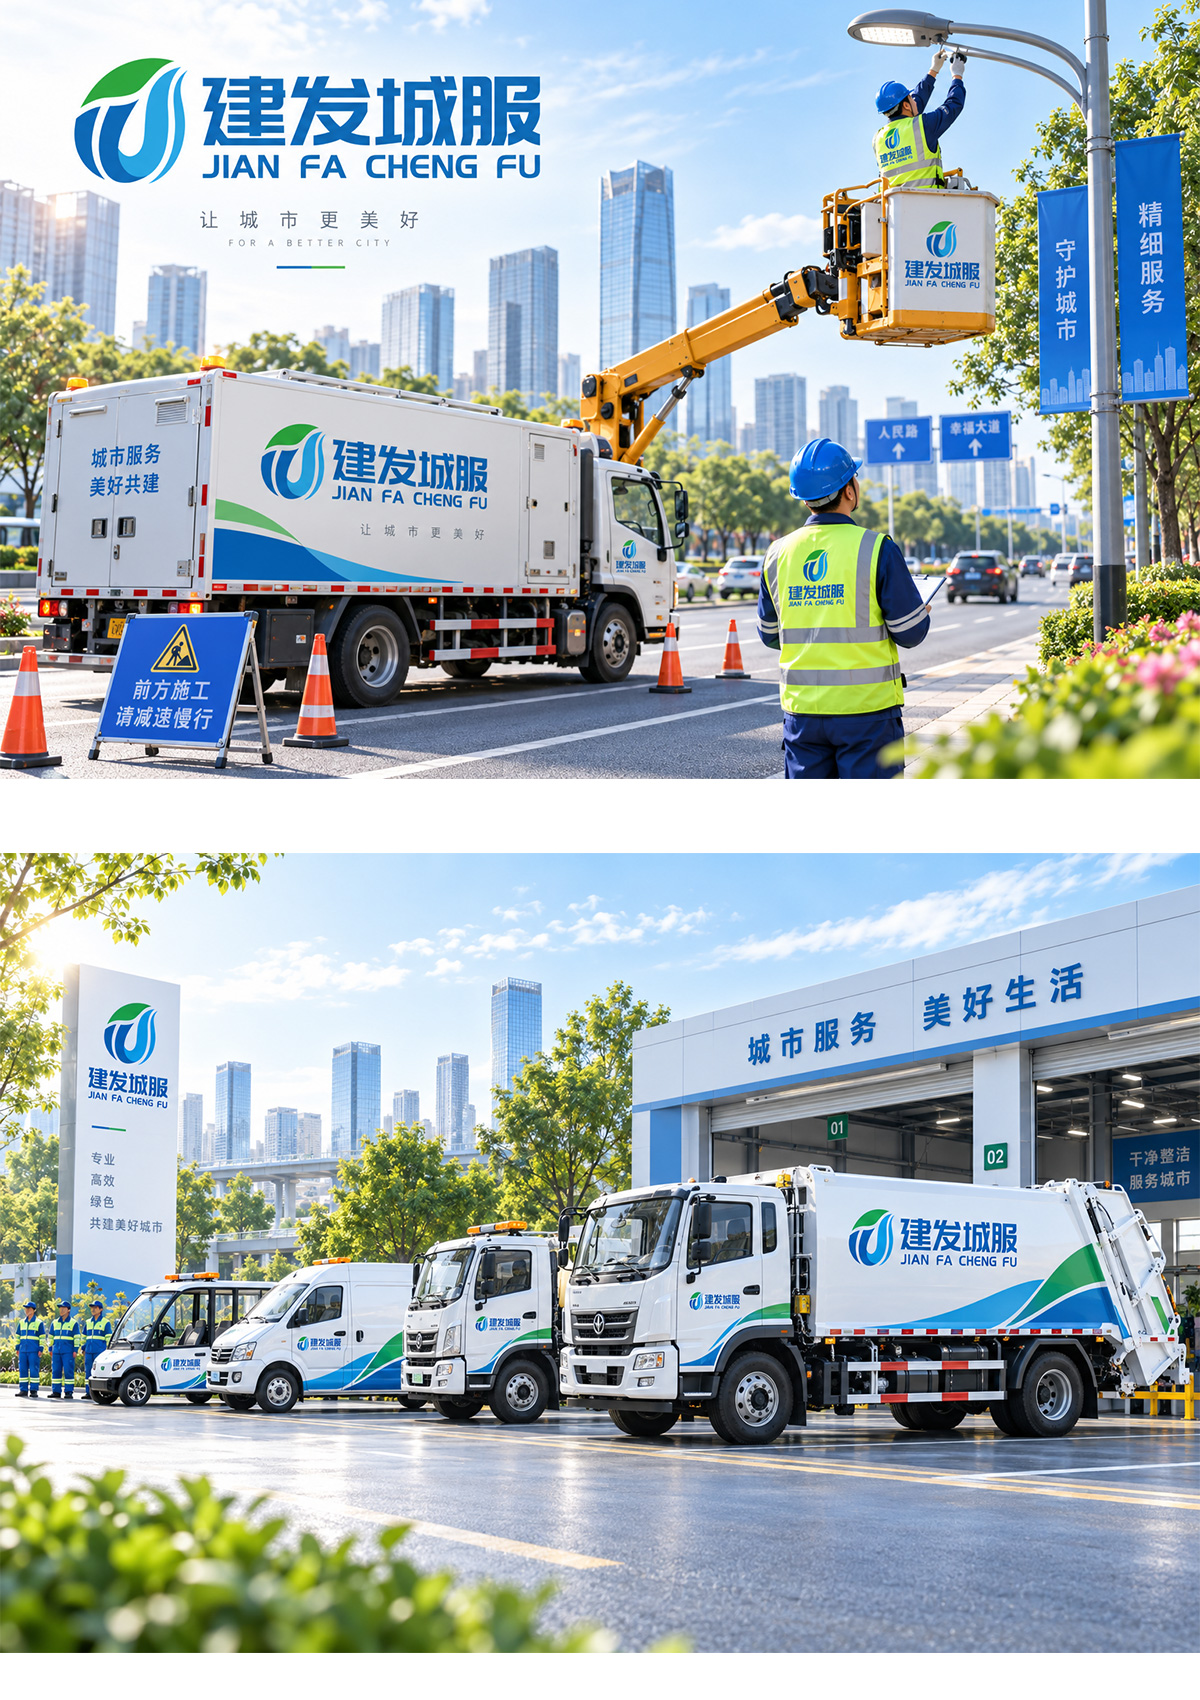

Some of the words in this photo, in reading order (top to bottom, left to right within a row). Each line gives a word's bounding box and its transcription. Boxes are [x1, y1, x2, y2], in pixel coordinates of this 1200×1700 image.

[880, 146, 912, 163] 建发城服
[1139, 202, 1164, 314] 精细服务
[905, 260, 980, 280] 建发城服
[1056, 239, 1077, 341] 守护城市
[878, 424, 918, 439] 人民路
[950, 420, 1000, 435] 幸福大道
[92, 443, 161, 468] 城市服务
[333, 440, 488, 493] 建发城服
[90, 472, 160, 497] 美好共建
[332, 486, 372, 502] JIAN
[382, 489, 404, 504] FA
[413, 492, 462, 508] CHENG
[469, 496, 488, 510] FU
[360, 523, 485, 541] 让城市更美好
[788, 584, 844, 601] 建发城服
[133, 679, 210, 700] 前方施工
[116, 706, 213, 730] 请减速慢行
[748, 1011, 877, 1065] 城市服务
[922, 963, 1084, 1031] 美好生活
[88, 1067, 168, 1098] 建发城服
[831, 1121, 843, 1136] 01
[92, 1152, 115, 1166] 专业
[987, 1149, 1003, 1165] 02
[1129, 1147, 1191, 1167] 干净整洁
[91, 1174, 114, 1187] 高效
[1129, 1170, 1190, 1190] 服务城市
[90, 1196, 114, 1208] 绿色
[90, 1217, 162, 1233] 共建美好城市
[900, 1217, 1017, 1253] 建发城服
